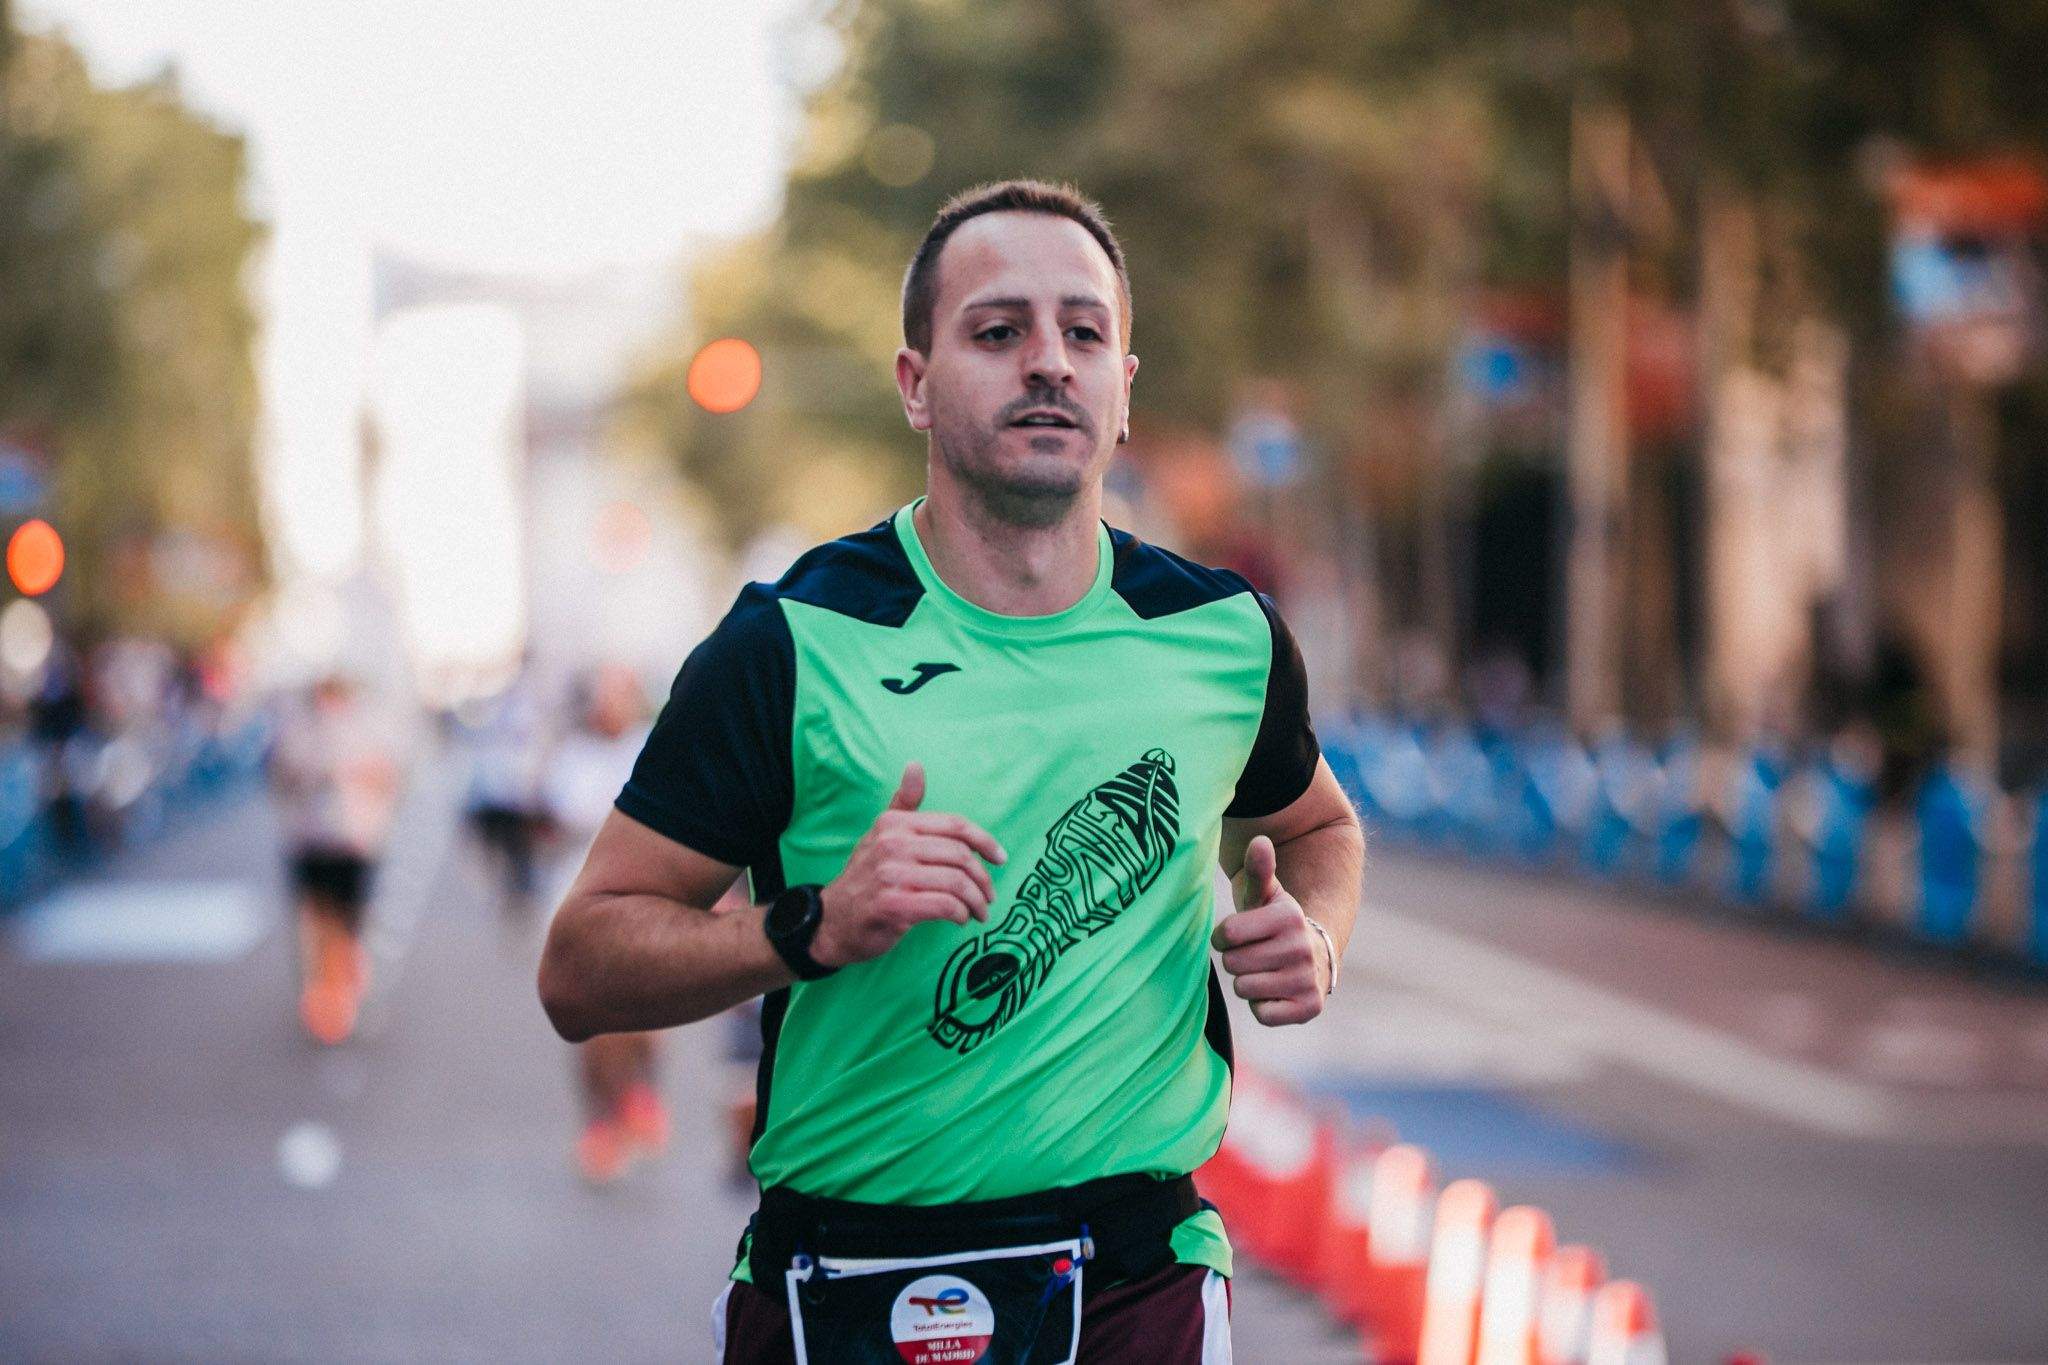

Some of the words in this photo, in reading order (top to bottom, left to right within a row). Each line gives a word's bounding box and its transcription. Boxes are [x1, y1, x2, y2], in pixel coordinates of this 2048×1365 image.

[927, 1340, 961, 1351] MILLA
[915, 1354, 930, 1364] DE
[932, 1349, 975, 1361] MADRID
